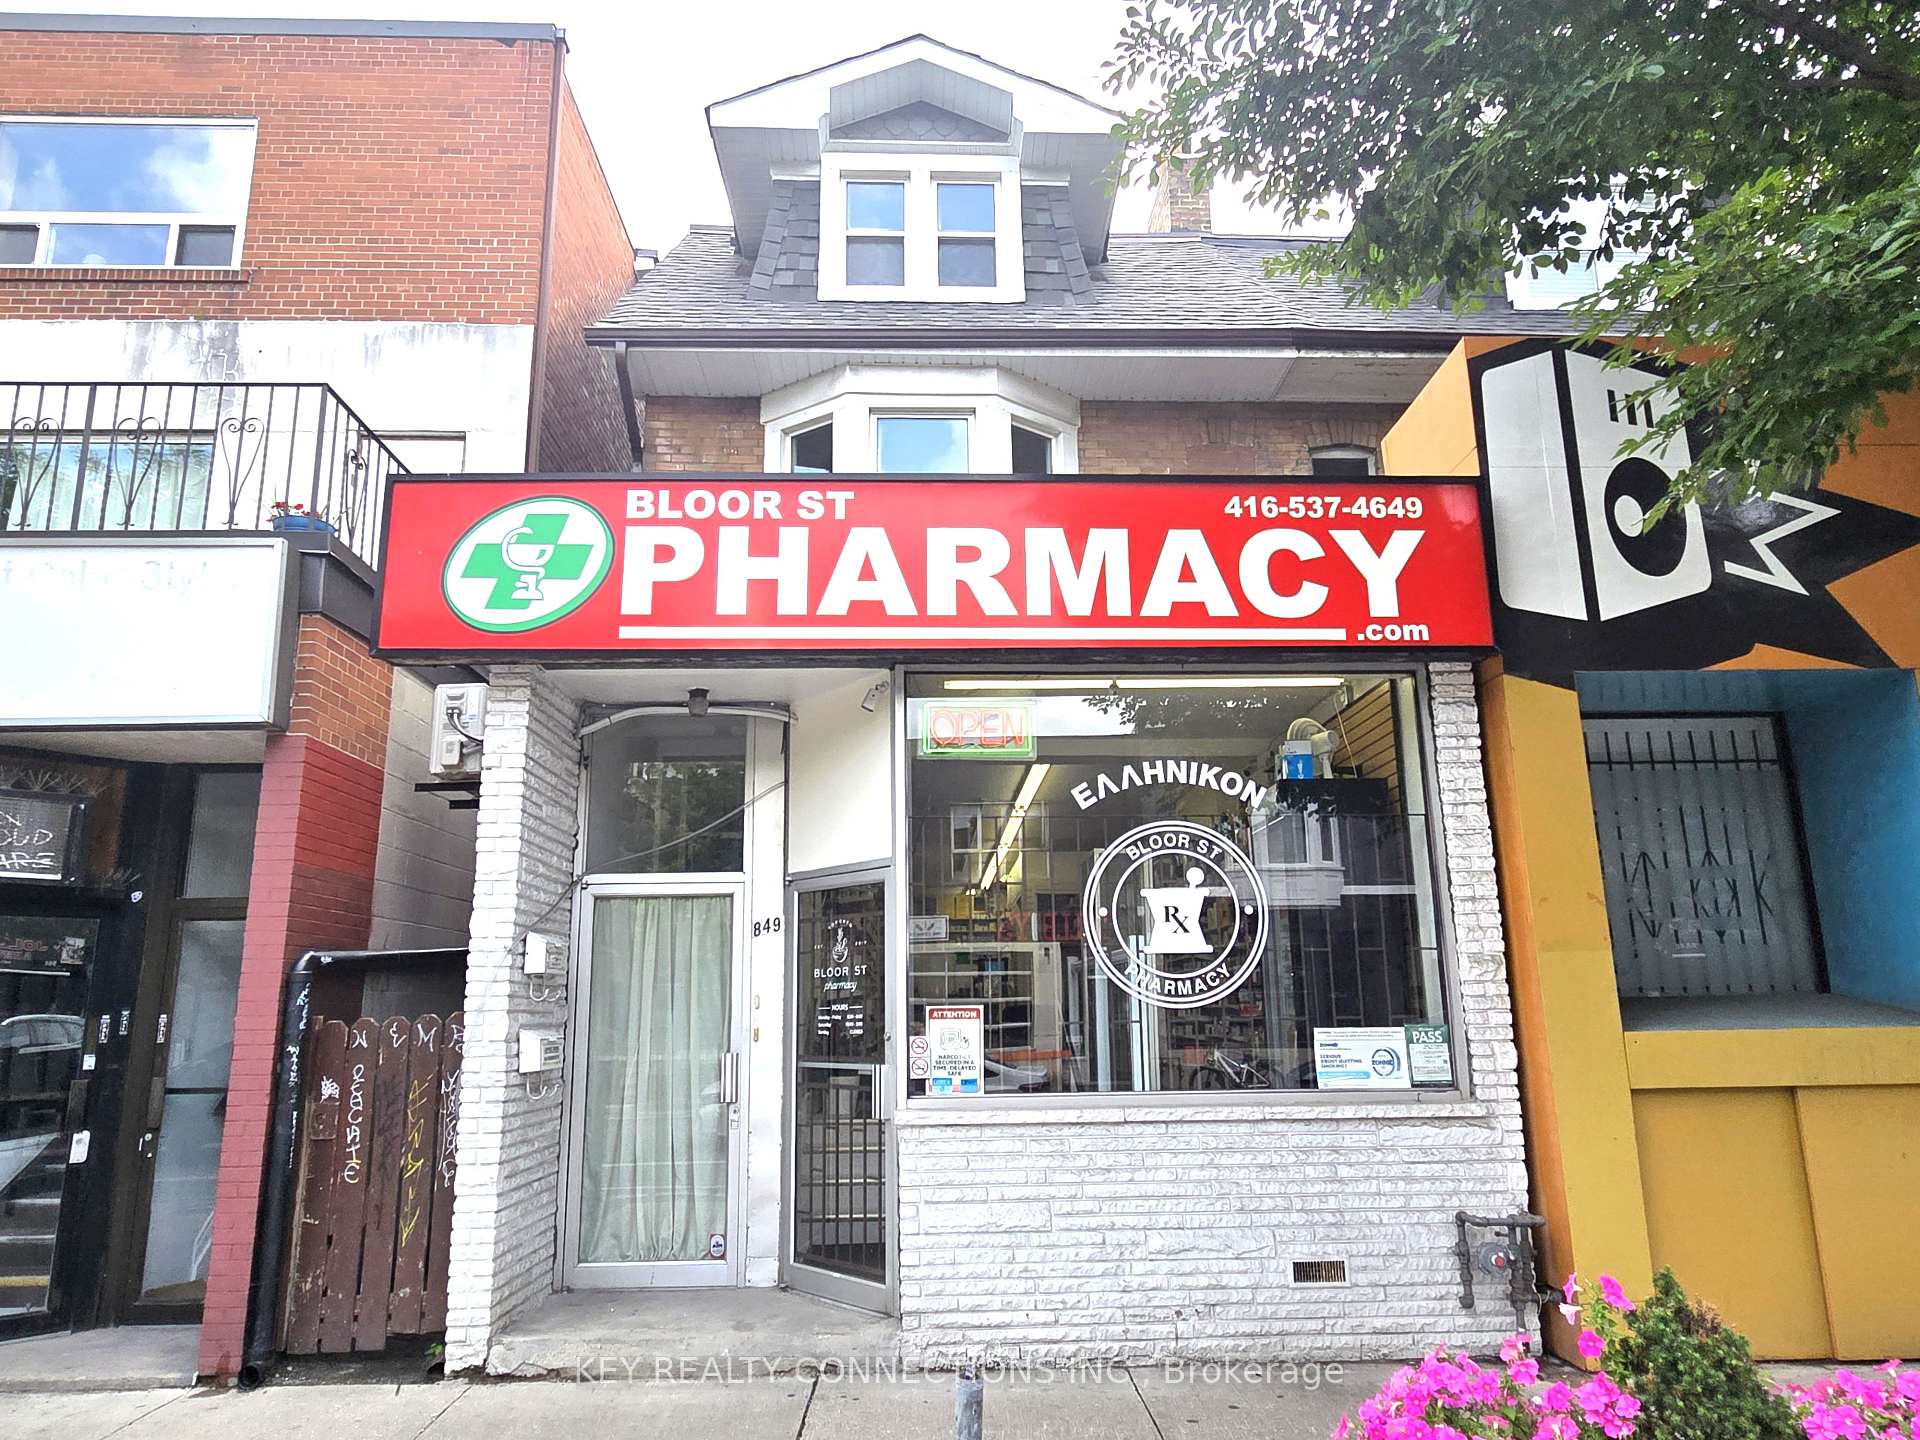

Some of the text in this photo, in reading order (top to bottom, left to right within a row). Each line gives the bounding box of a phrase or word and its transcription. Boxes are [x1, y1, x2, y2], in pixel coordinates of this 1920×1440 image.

[625, 489, 855, 520] BLOOR ST
[1224, 495, 1424, 519] 416-537-4649
[620, 525, 1426, 619] PHARMACY
[1357, 621, 1430, 642] .com
[930, 708, 1025, 746] OPEN
[1125, 833, 1223, 861] BLOOR ST
[753, 917, 781, 937] 849
[814, 964, 868, 978] BLOOR ST
[1124, 962, 1231, 996] PHARMACY
[823, 980, 857, 992] pharmacy
[932, 1010, 977, 1018] ATTENTION
[1412, 1031, 1443, 1043] PASS
